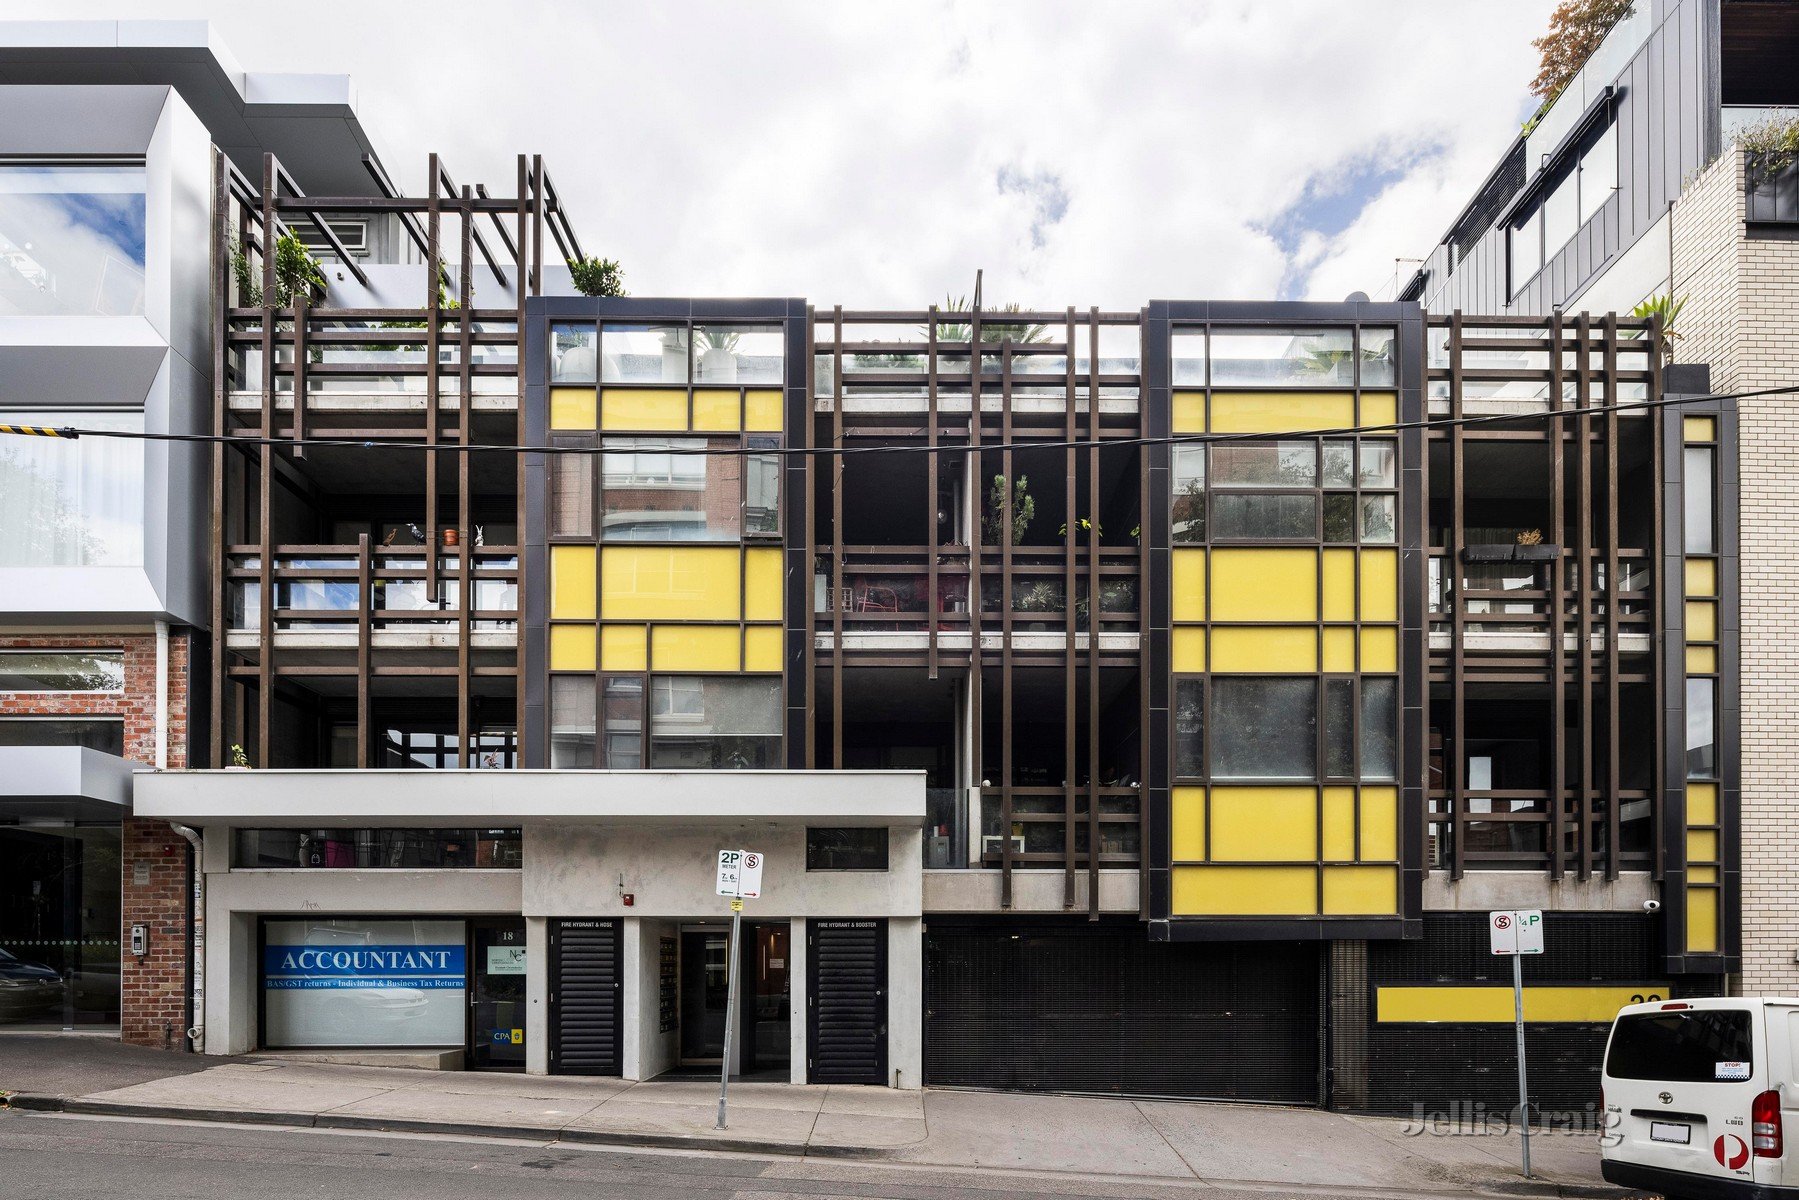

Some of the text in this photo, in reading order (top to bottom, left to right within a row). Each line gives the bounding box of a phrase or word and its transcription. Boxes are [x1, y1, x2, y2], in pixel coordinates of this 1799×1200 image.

[721, 853, 740, 863] 2P
[503, 931, 513, 940] 18
[281, 951, 451, 969] ACCOUNTANT
